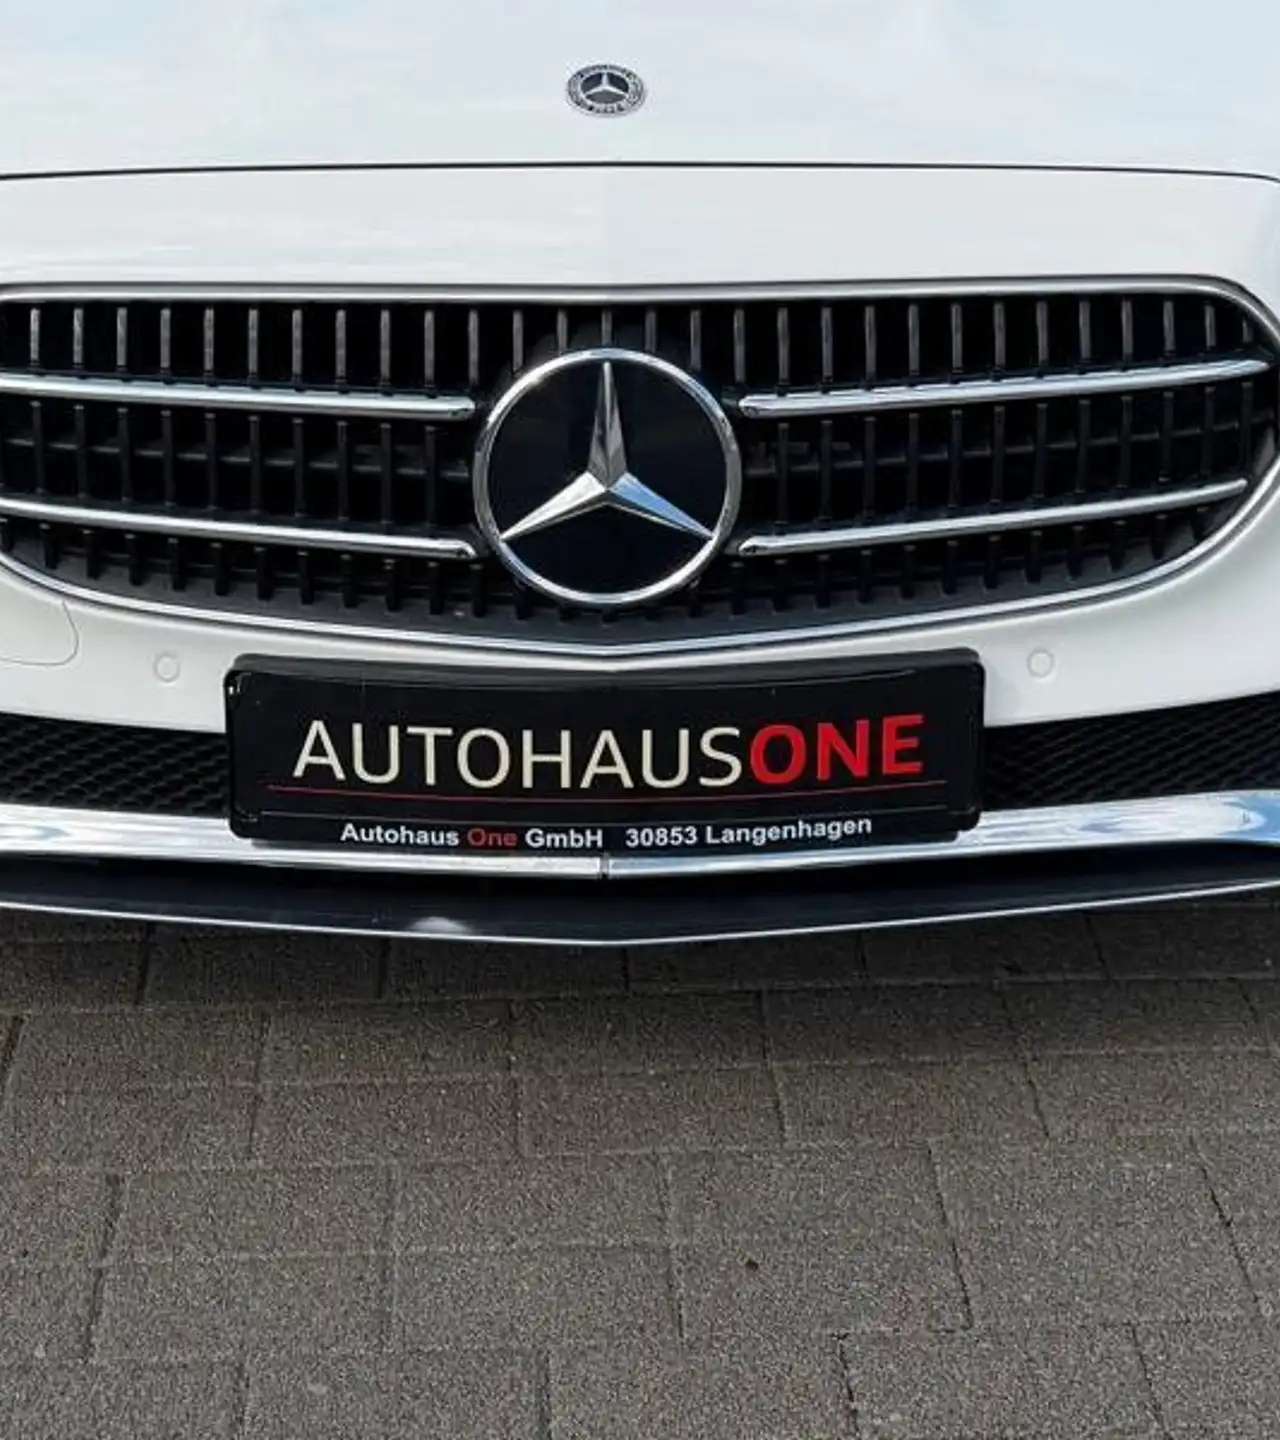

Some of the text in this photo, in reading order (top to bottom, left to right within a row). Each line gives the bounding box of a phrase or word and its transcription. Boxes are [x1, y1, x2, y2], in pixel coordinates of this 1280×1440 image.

[340, 817, 872, 848] Autohaus One GmbH 30853 Langenhagen
